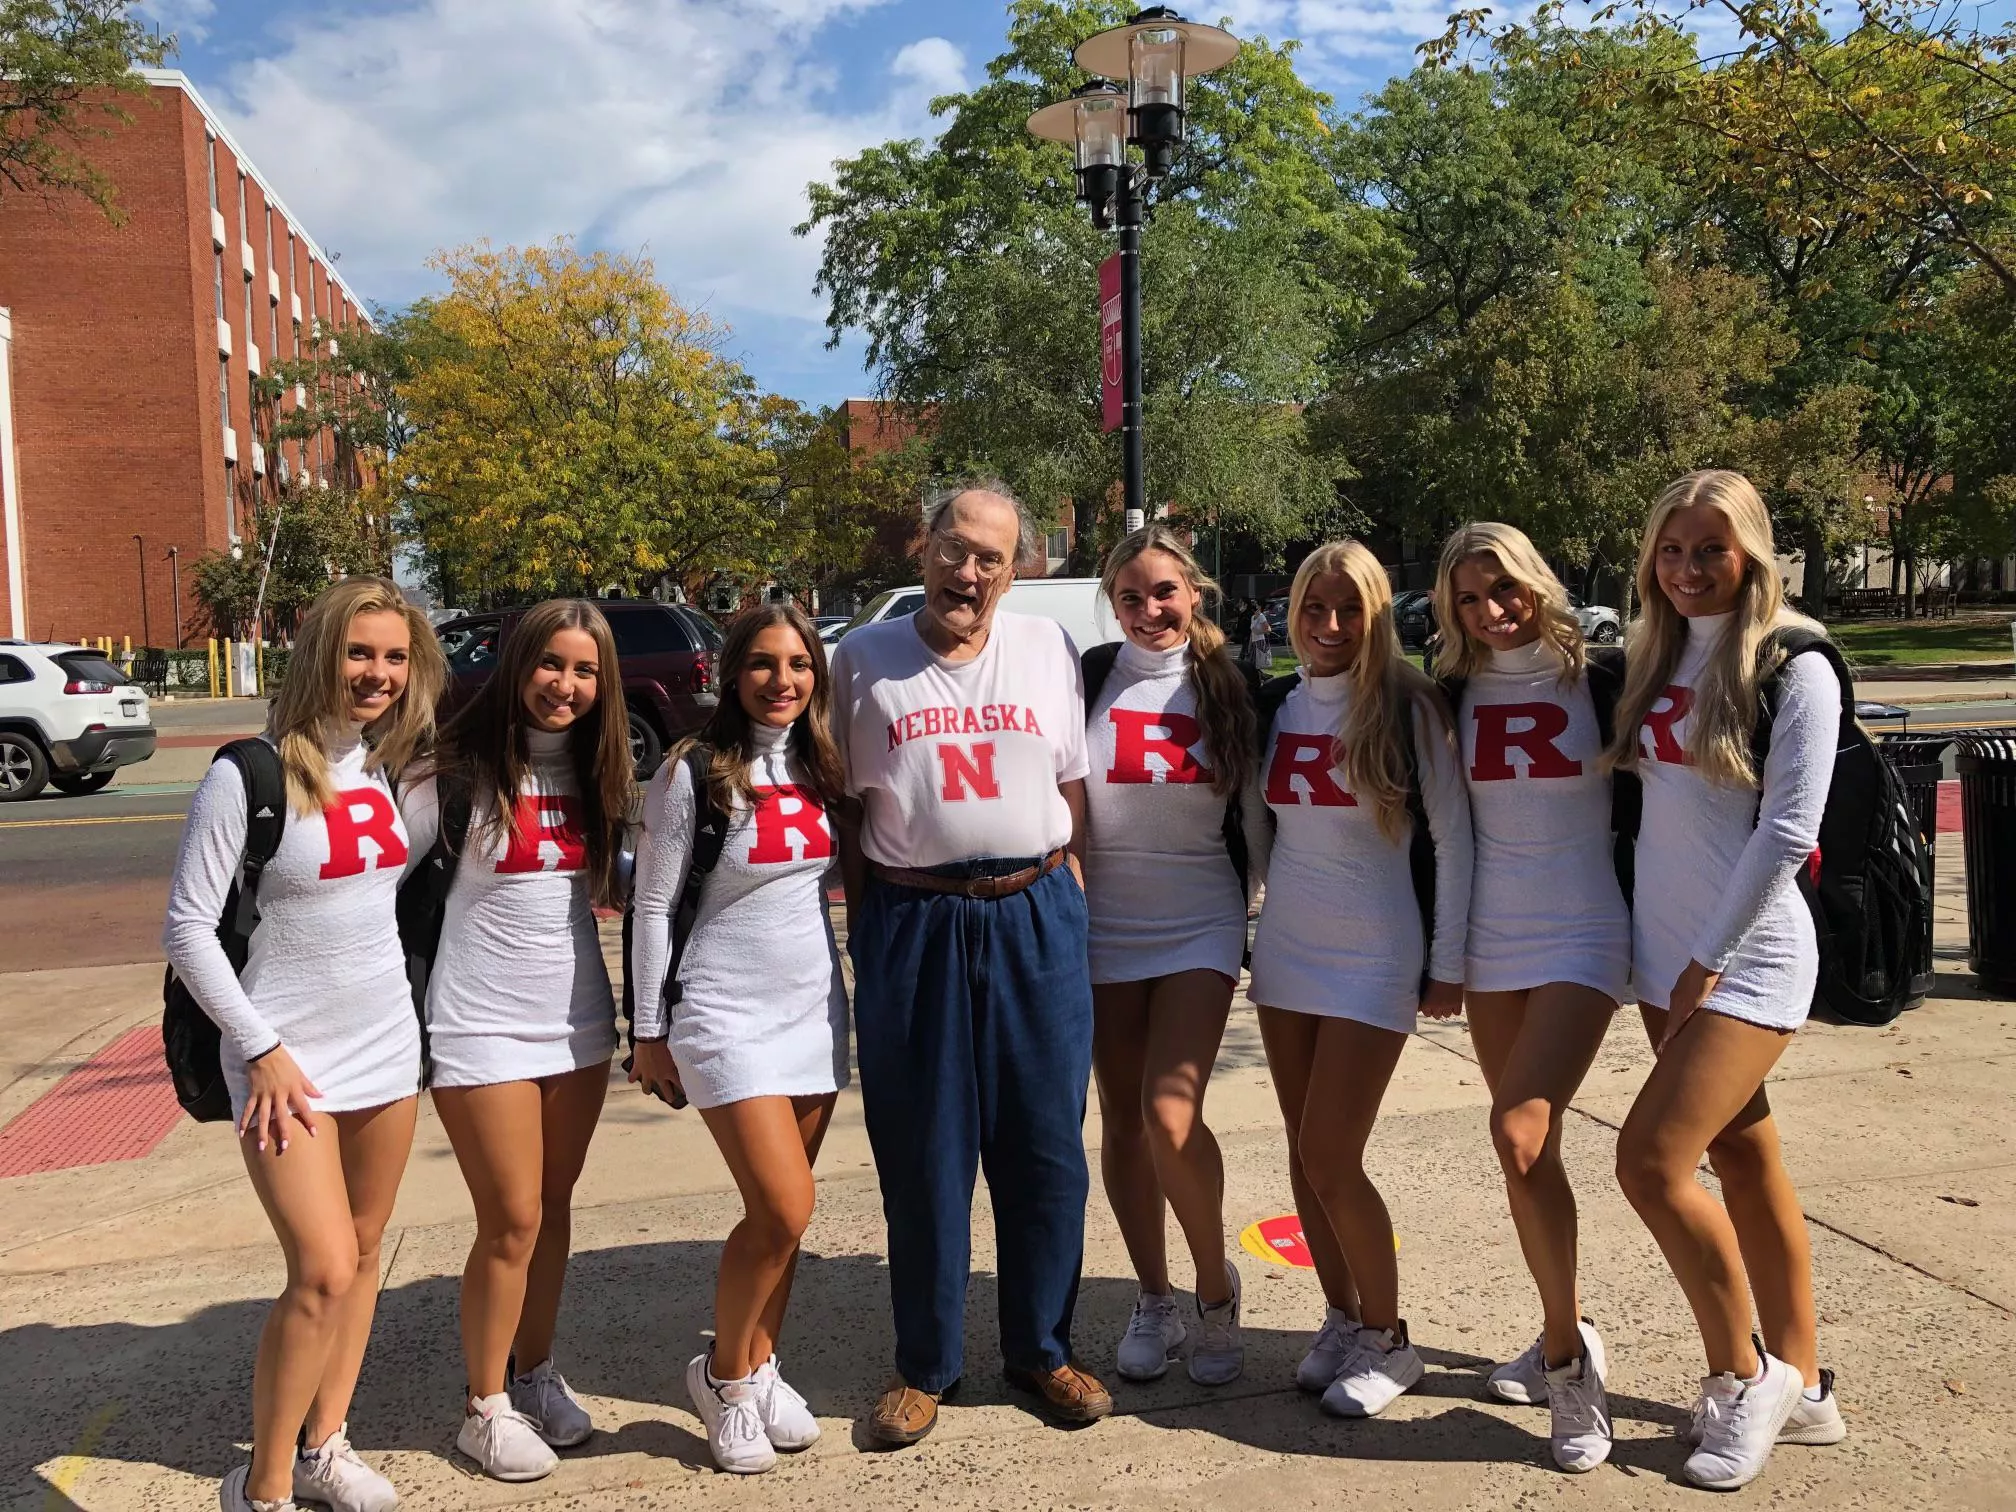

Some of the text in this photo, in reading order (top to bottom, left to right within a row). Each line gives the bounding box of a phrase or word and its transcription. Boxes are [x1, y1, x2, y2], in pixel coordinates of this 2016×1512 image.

[887, 704, 1044, 753] NEBRASKA
[1106, 707, 1216, 783] R
[1470, 702, 1582, 781] R
[936, 739, 1002, 803] N
[1264, 731, 1358, 807] R
[319, 787, 409, 880] R
[495, 795, 590, 873] R
[748, 784, 838, 864] R
